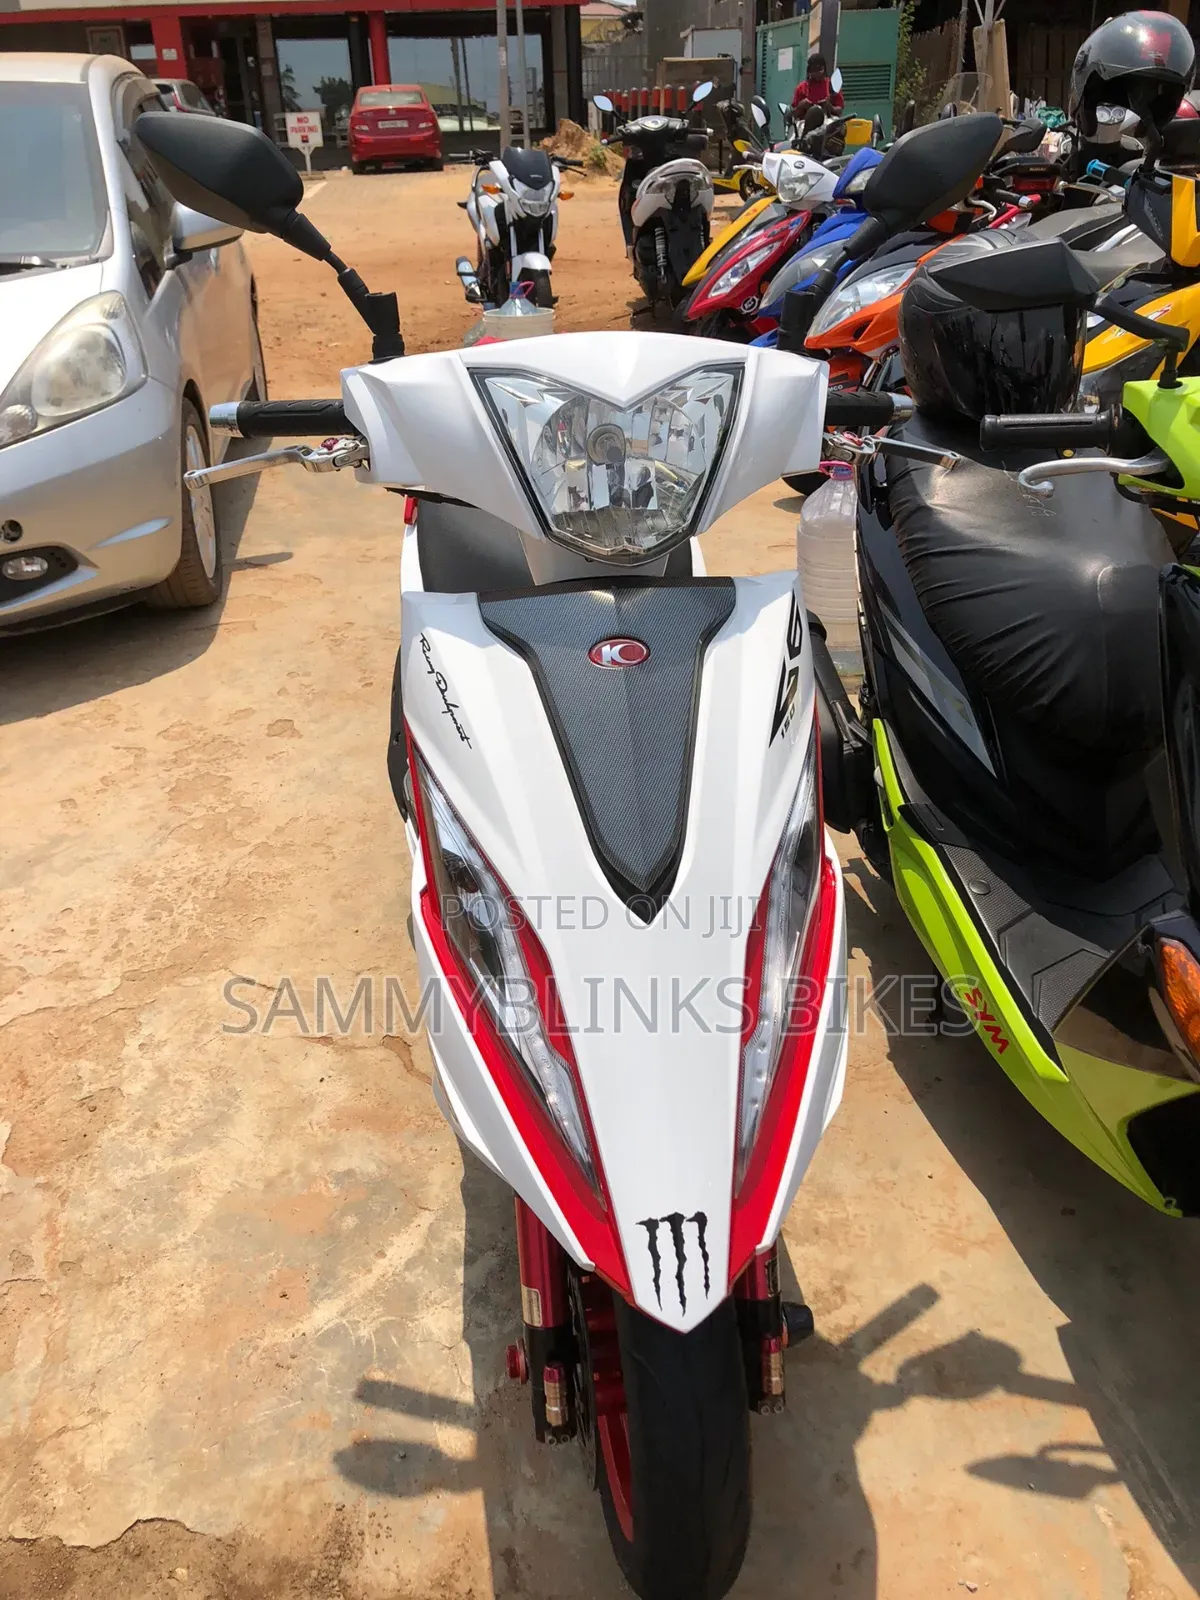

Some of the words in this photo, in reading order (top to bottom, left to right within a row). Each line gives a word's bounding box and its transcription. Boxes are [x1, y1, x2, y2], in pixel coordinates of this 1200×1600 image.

[296, 116, 309, 124] NO
[780, 703, 796, 740] 150
[964, 987, 1009, 1055] SYM
